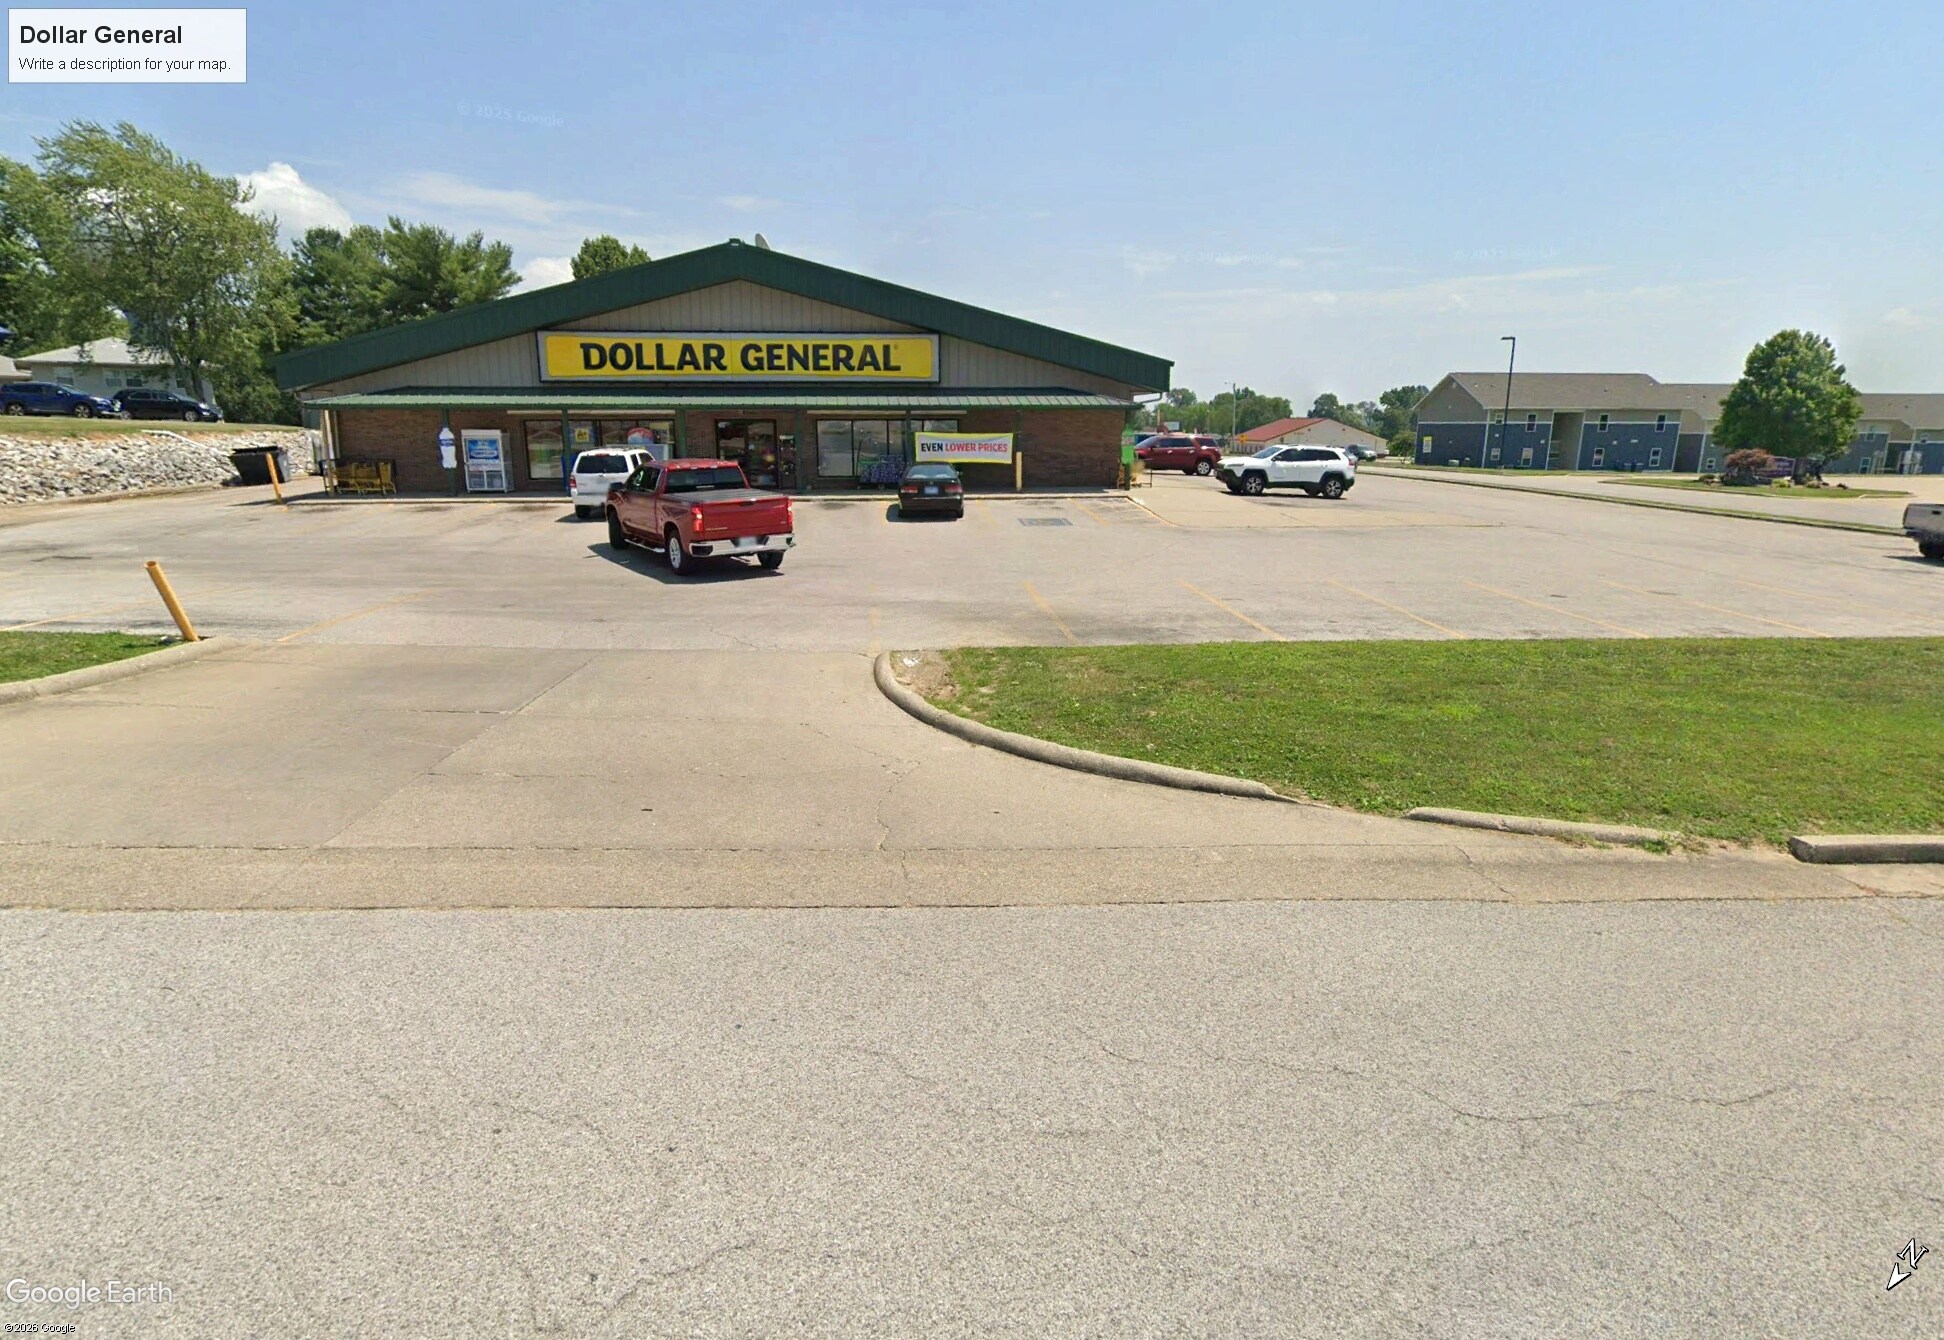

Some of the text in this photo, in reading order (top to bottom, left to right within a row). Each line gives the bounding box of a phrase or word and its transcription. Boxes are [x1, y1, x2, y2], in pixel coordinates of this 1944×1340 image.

[579, 342, 901, 372] DOLLAR GENERAL
[920, 442, 1009, 453] EVEN LOWER PRICES
